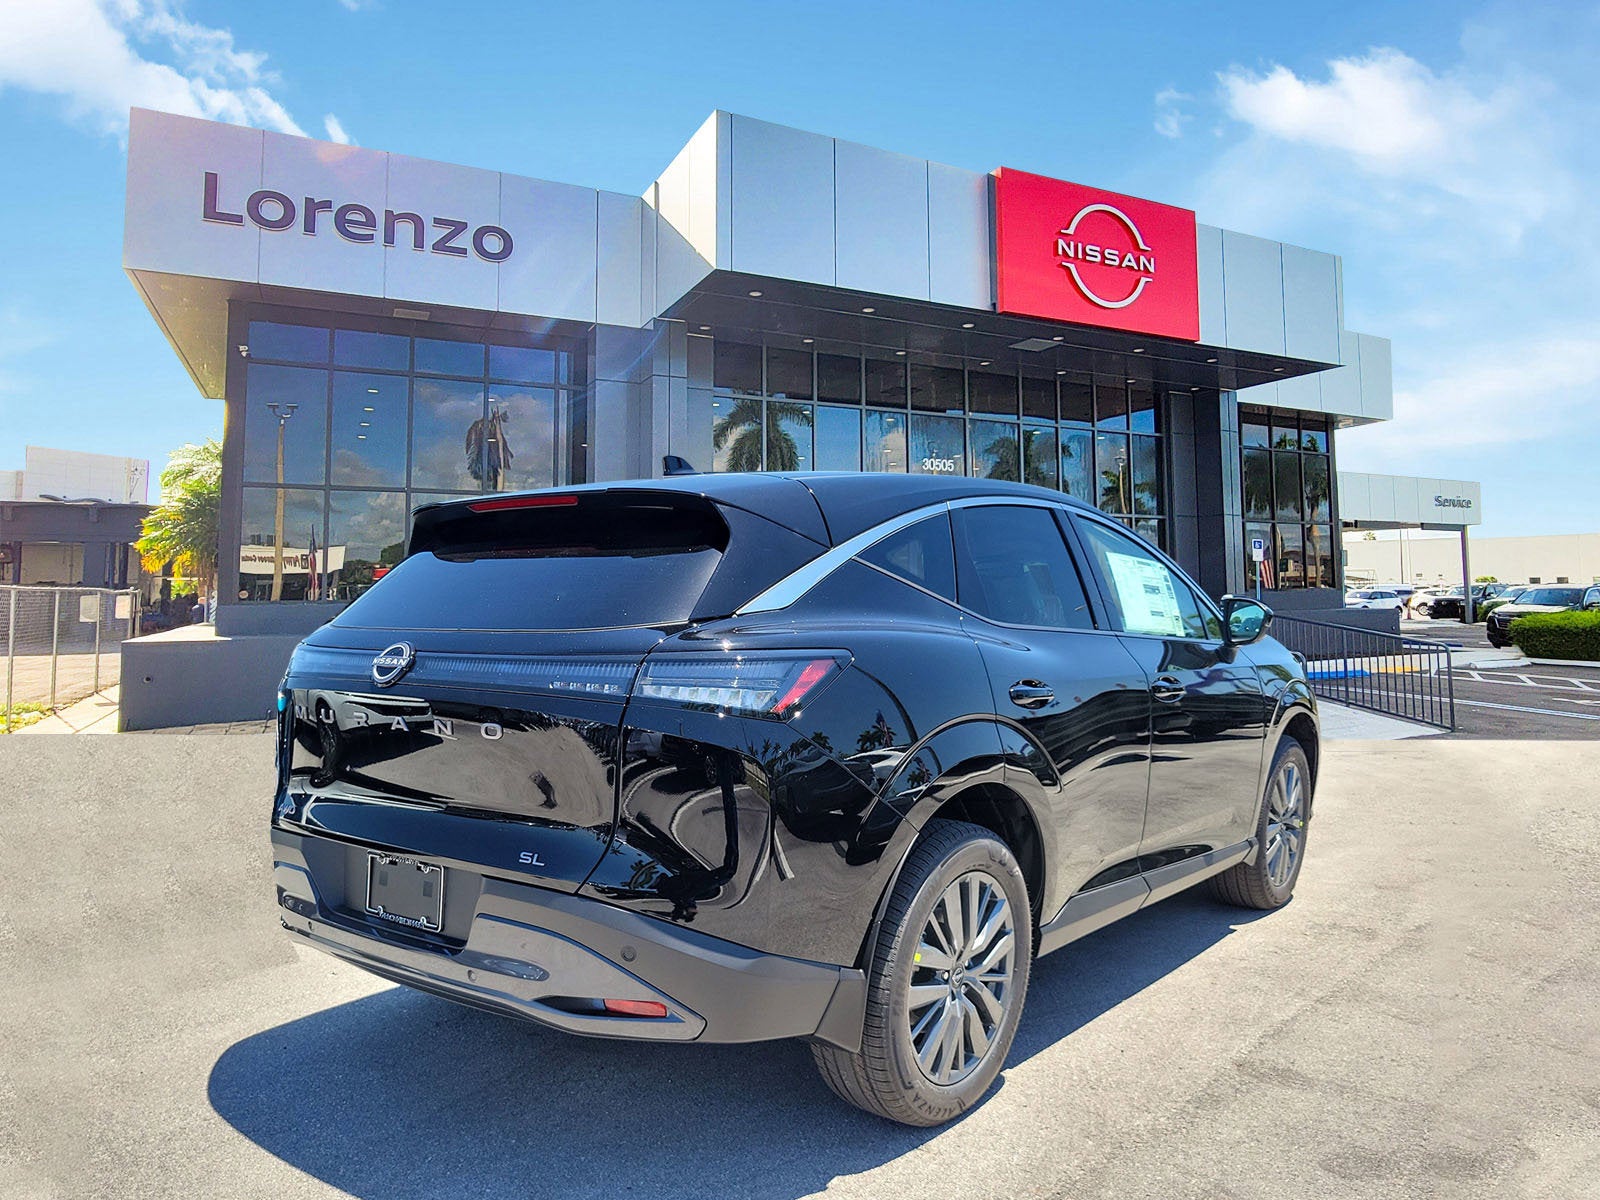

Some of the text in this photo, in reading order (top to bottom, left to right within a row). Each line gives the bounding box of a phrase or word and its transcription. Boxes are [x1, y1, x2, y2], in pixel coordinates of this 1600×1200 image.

[202, 171, 515, 262] Lorenzo
[1057, 238, 1155, 273] NISSAN
[922, 458, 955, 472] 30505
[1434, 495, 1472, 509] Service
[372, 656, 410, 667] NISSAN
[295, 705, 504, 740] MURANO
[519, 851, 545, 866] SL
